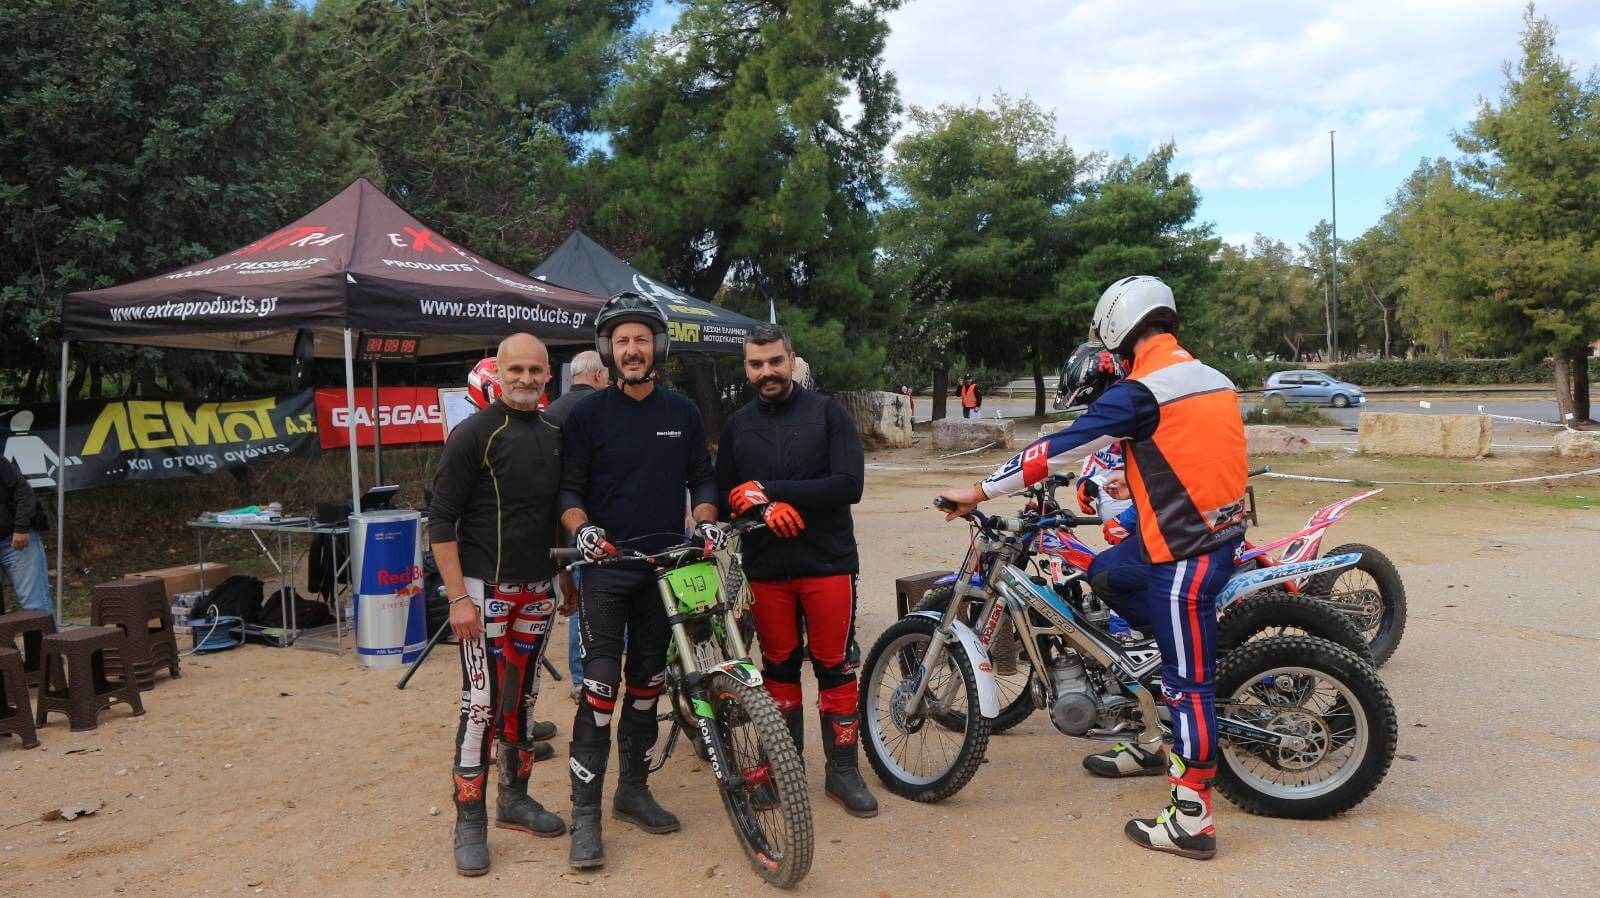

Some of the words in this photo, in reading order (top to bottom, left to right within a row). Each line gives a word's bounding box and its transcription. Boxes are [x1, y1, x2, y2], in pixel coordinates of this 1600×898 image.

[382, 258, 474, 272] PRODUCTS
[110, 296, 278, 321] www.extraproducts.gr
[420, 299, 587, 329] www.extraproducts.gr
[667, 321, 700, 343] ΕΜΟΤ
[331, 404, 443, 428] GASGAS
[163, 454, 216, 469] στους
[226, 443, 290, 463] αγώνες
[377, 565, 411, 587] Red
[698, 718, 712, 745] NON
[707, 746, 723, 780] STOP
